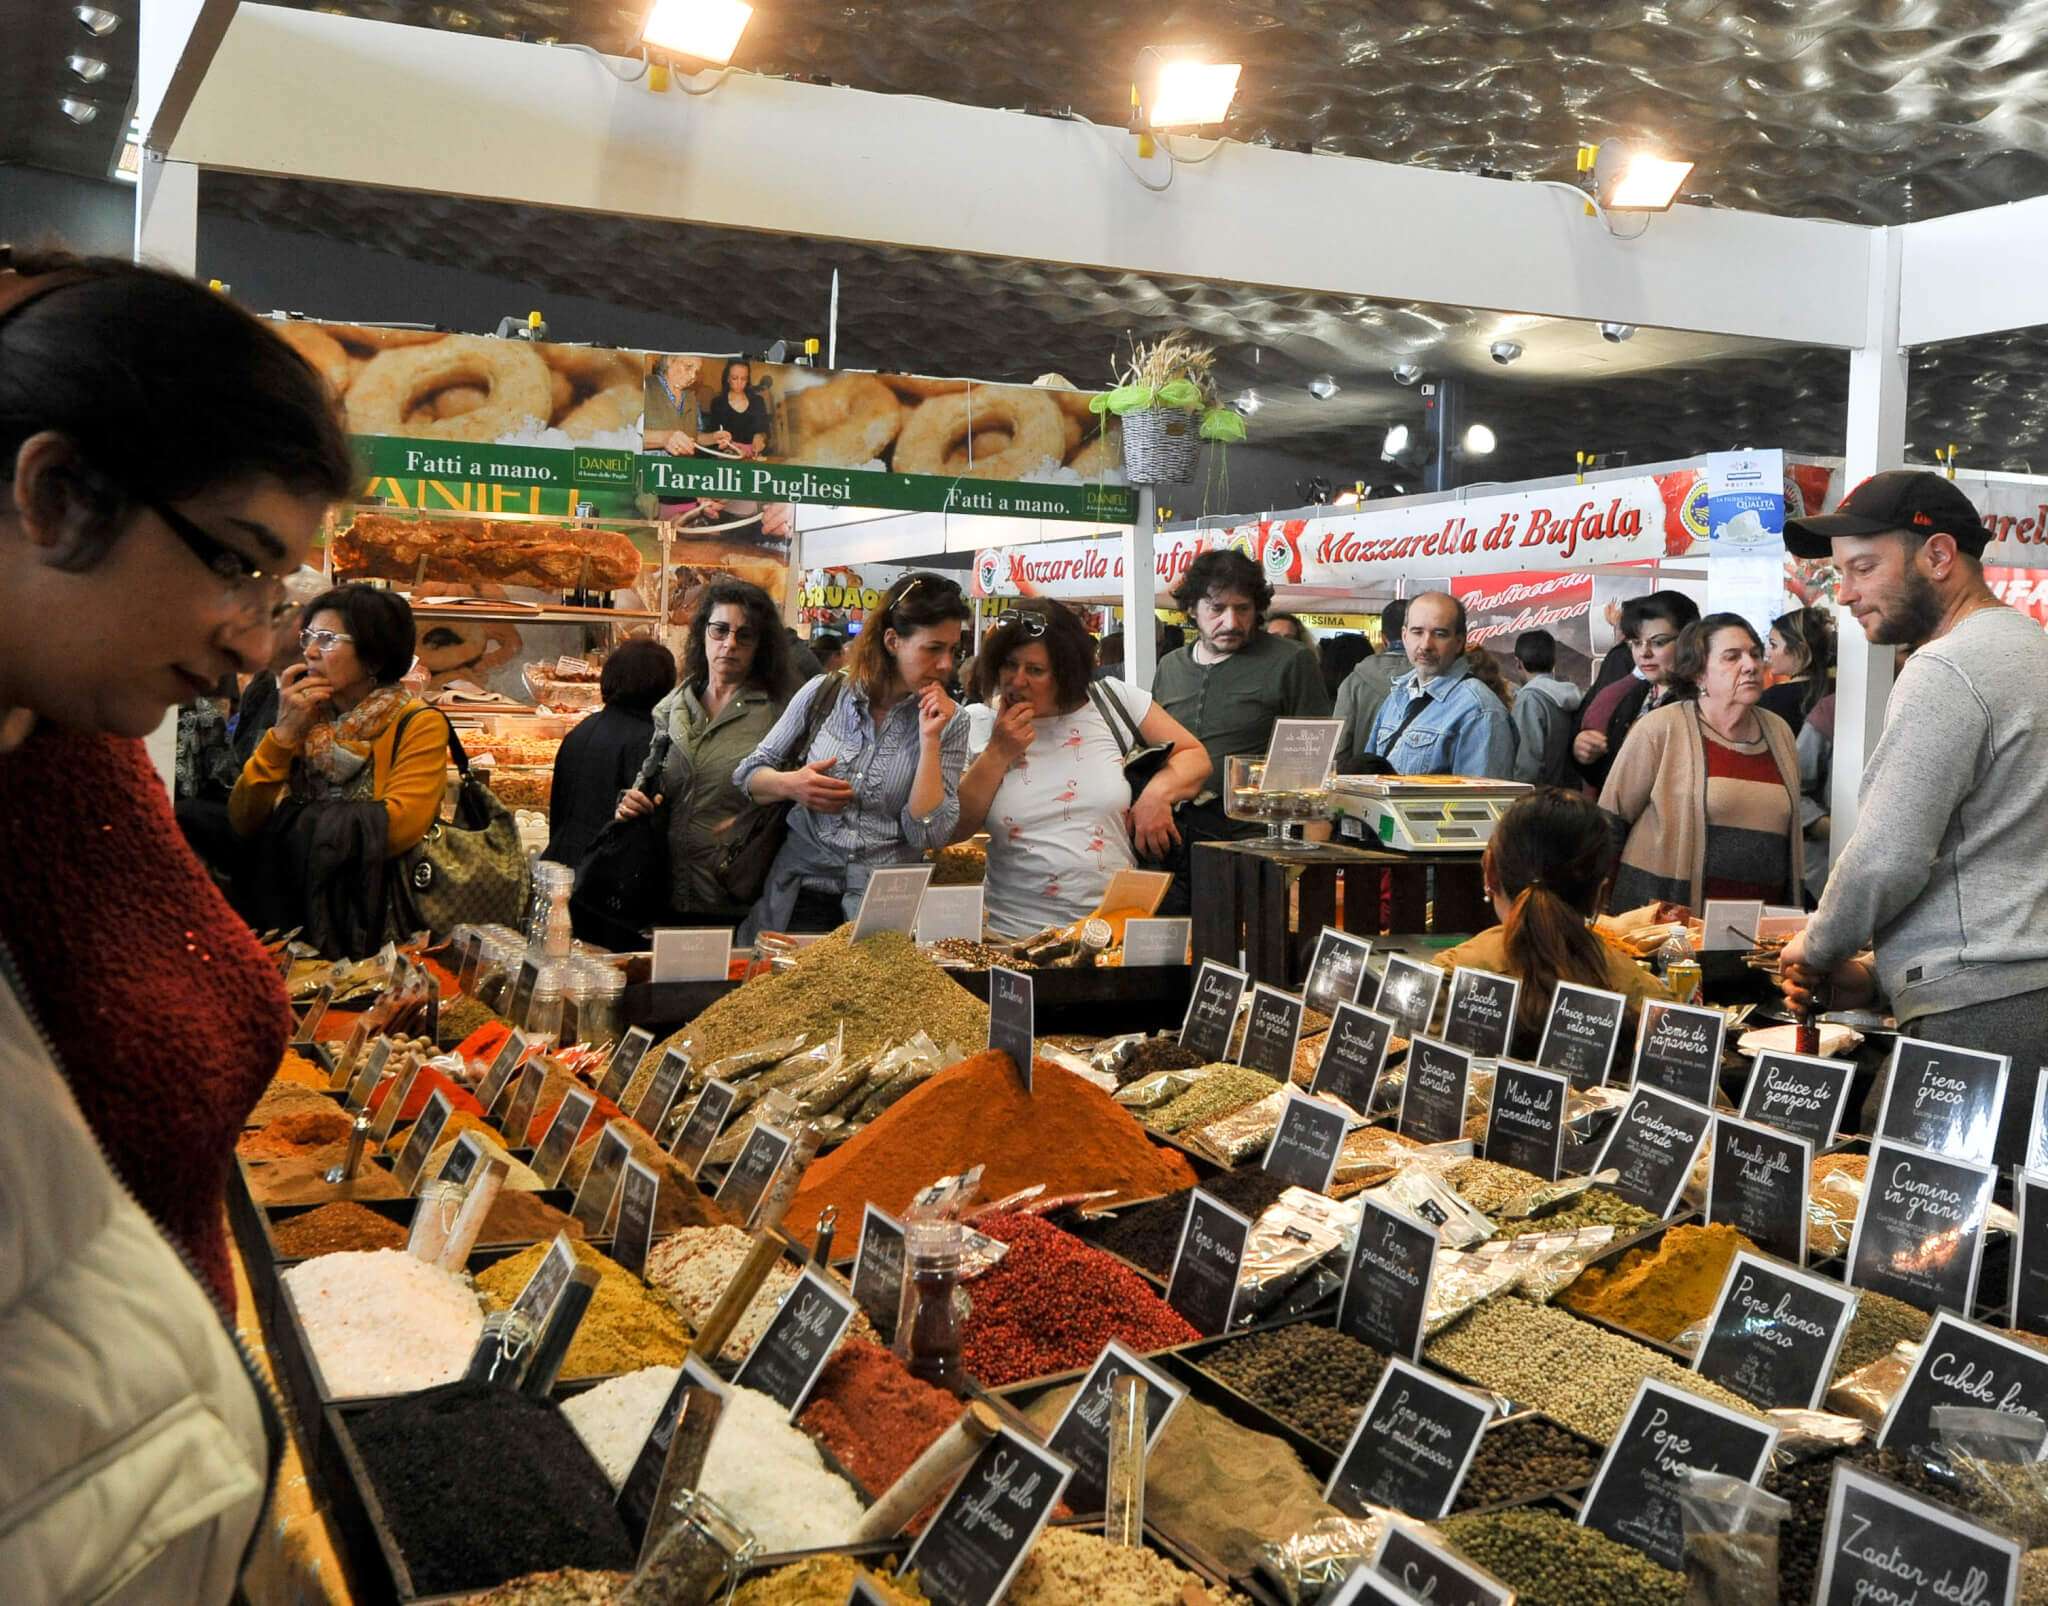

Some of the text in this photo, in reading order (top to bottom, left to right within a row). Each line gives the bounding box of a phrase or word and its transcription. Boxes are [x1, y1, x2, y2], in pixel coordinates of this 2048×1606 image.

[406, 450, 462, 475] Fatti
[469, 463, 482, 476] a
[490, 464, 558, 481] mano.
[579, 456, 628, 472] DANIELI
[651, 463, 851, 503] Taralli Pugliesi
[948, 488, 993, 509] Fatti
[998, 498, 1009, 510] a
[1015, 500, 1071, 514] mano.
[1316, 497, 1644, 565] Mozzarella di Bufala
[1005, 550, 1107, 584] Mozzarella
[1466, 600, 1592, 645] apoletana
[1586, 1012, 1615, 1028] verde
[1656, 1013, 1707, 1042] Semi di
[1648, 1035, 1709, 1056] papavero
[1763, 1066, 1832, 1100] Radice di
[1922, 1060, 1968, 1091] Fieno
[1504, 1079, 1553, 1112] Misto del
[1762, 1090, 1822, 1116] zenzero
[1915, 1086, 1965, 1109] greco
[1639, 1127, 1673, 1149] verde
[1892, 1161, 1961, 1204] Cumino
[1884, 1184, 1962, 1221] in grani
[1191, 1215, 1237, 1265] Pepe rosa
[1382, 1221, 1409, 1262] Pepe
[1732, 1275, 1825, 1338] Pepe bianco
[1929, 1353, 1997, 1403] Cubebe
[1372, 1412, 1392, 1435] del
[1391, 1389, 1452, 1443] Pepe grigio
[1641, 1407, 1693, 1462] Pepe
[1841, 1513, 1929, 1587] Zaatar
[1852, 1578, 1918, 1606] giord
